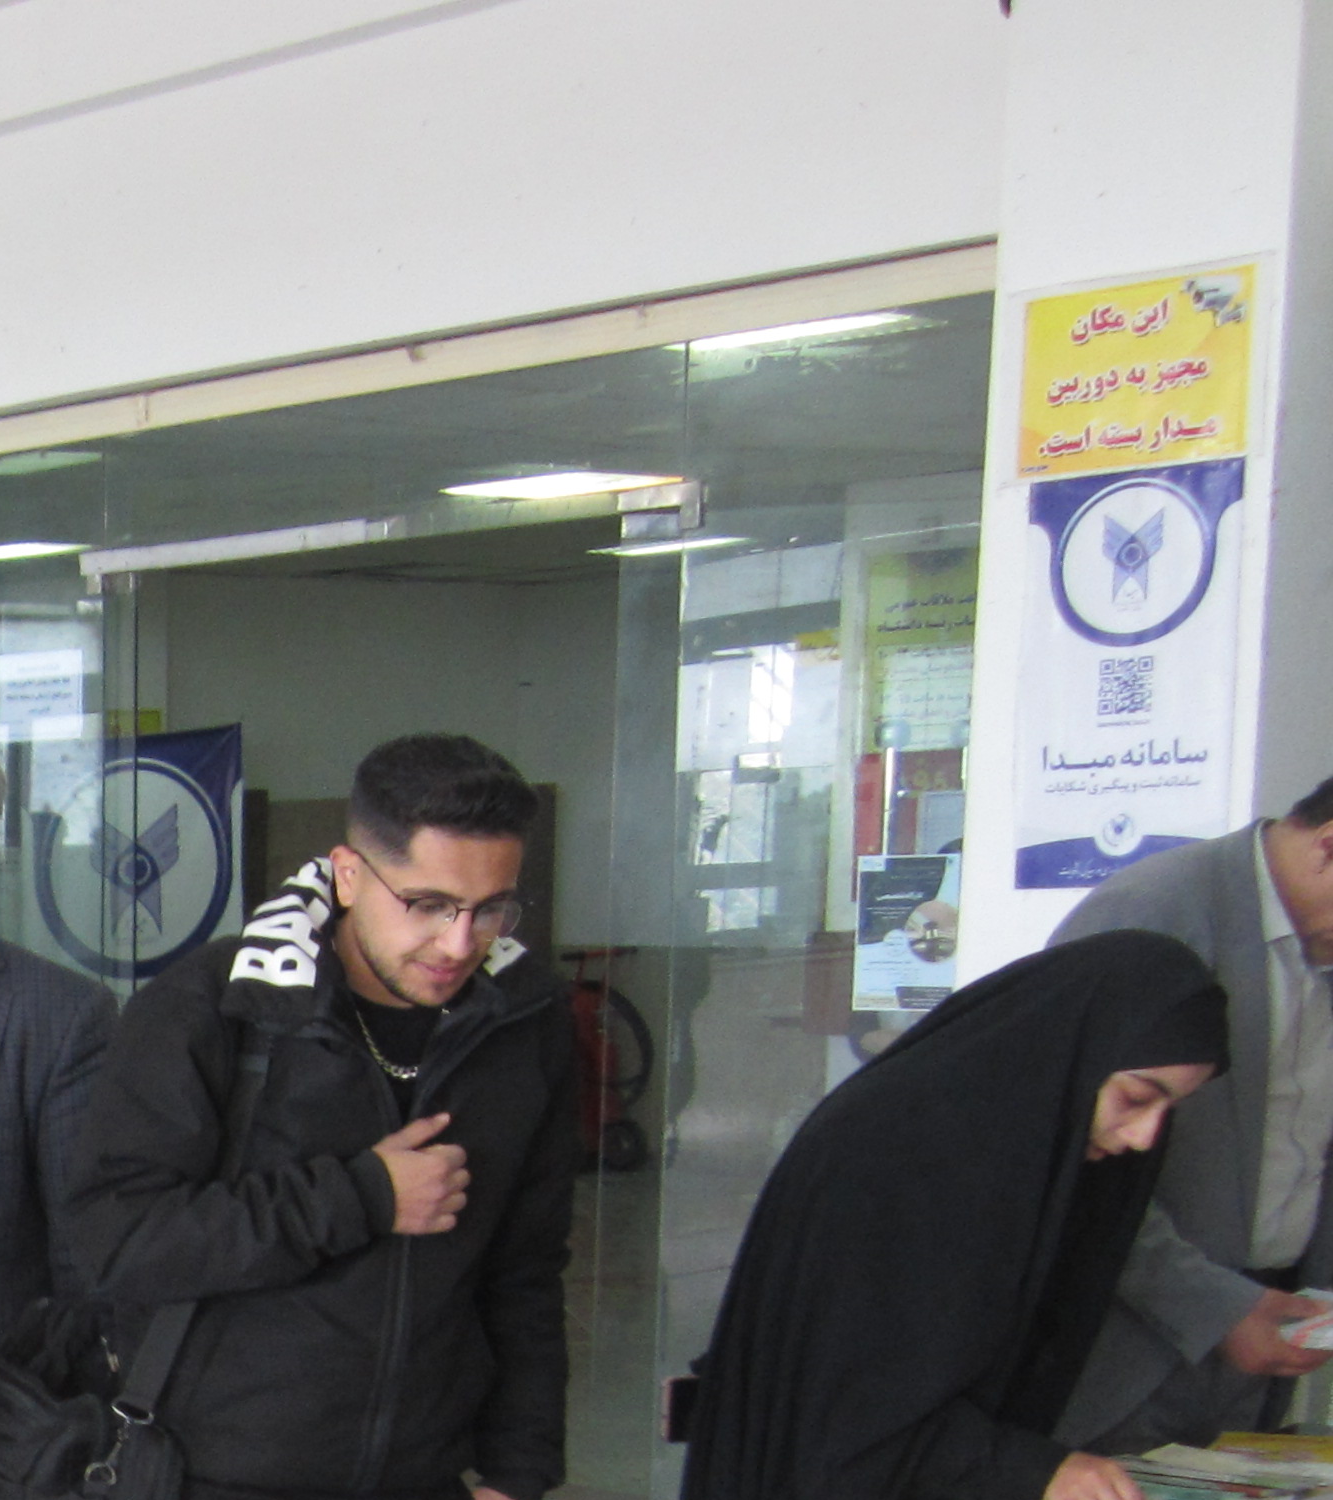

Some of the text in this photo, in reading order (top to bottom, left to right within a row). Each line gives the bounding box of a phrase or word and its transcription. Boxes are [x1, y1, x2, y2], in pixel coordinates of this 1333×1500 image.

[1070, 297, 1169, 346] این مکان
[1046, 358, 1209, 406] مجهز به دوربین
[1098, 424, 1143, 450] بسته
[1043, 738, 1208, 778] سامانه مبدا
